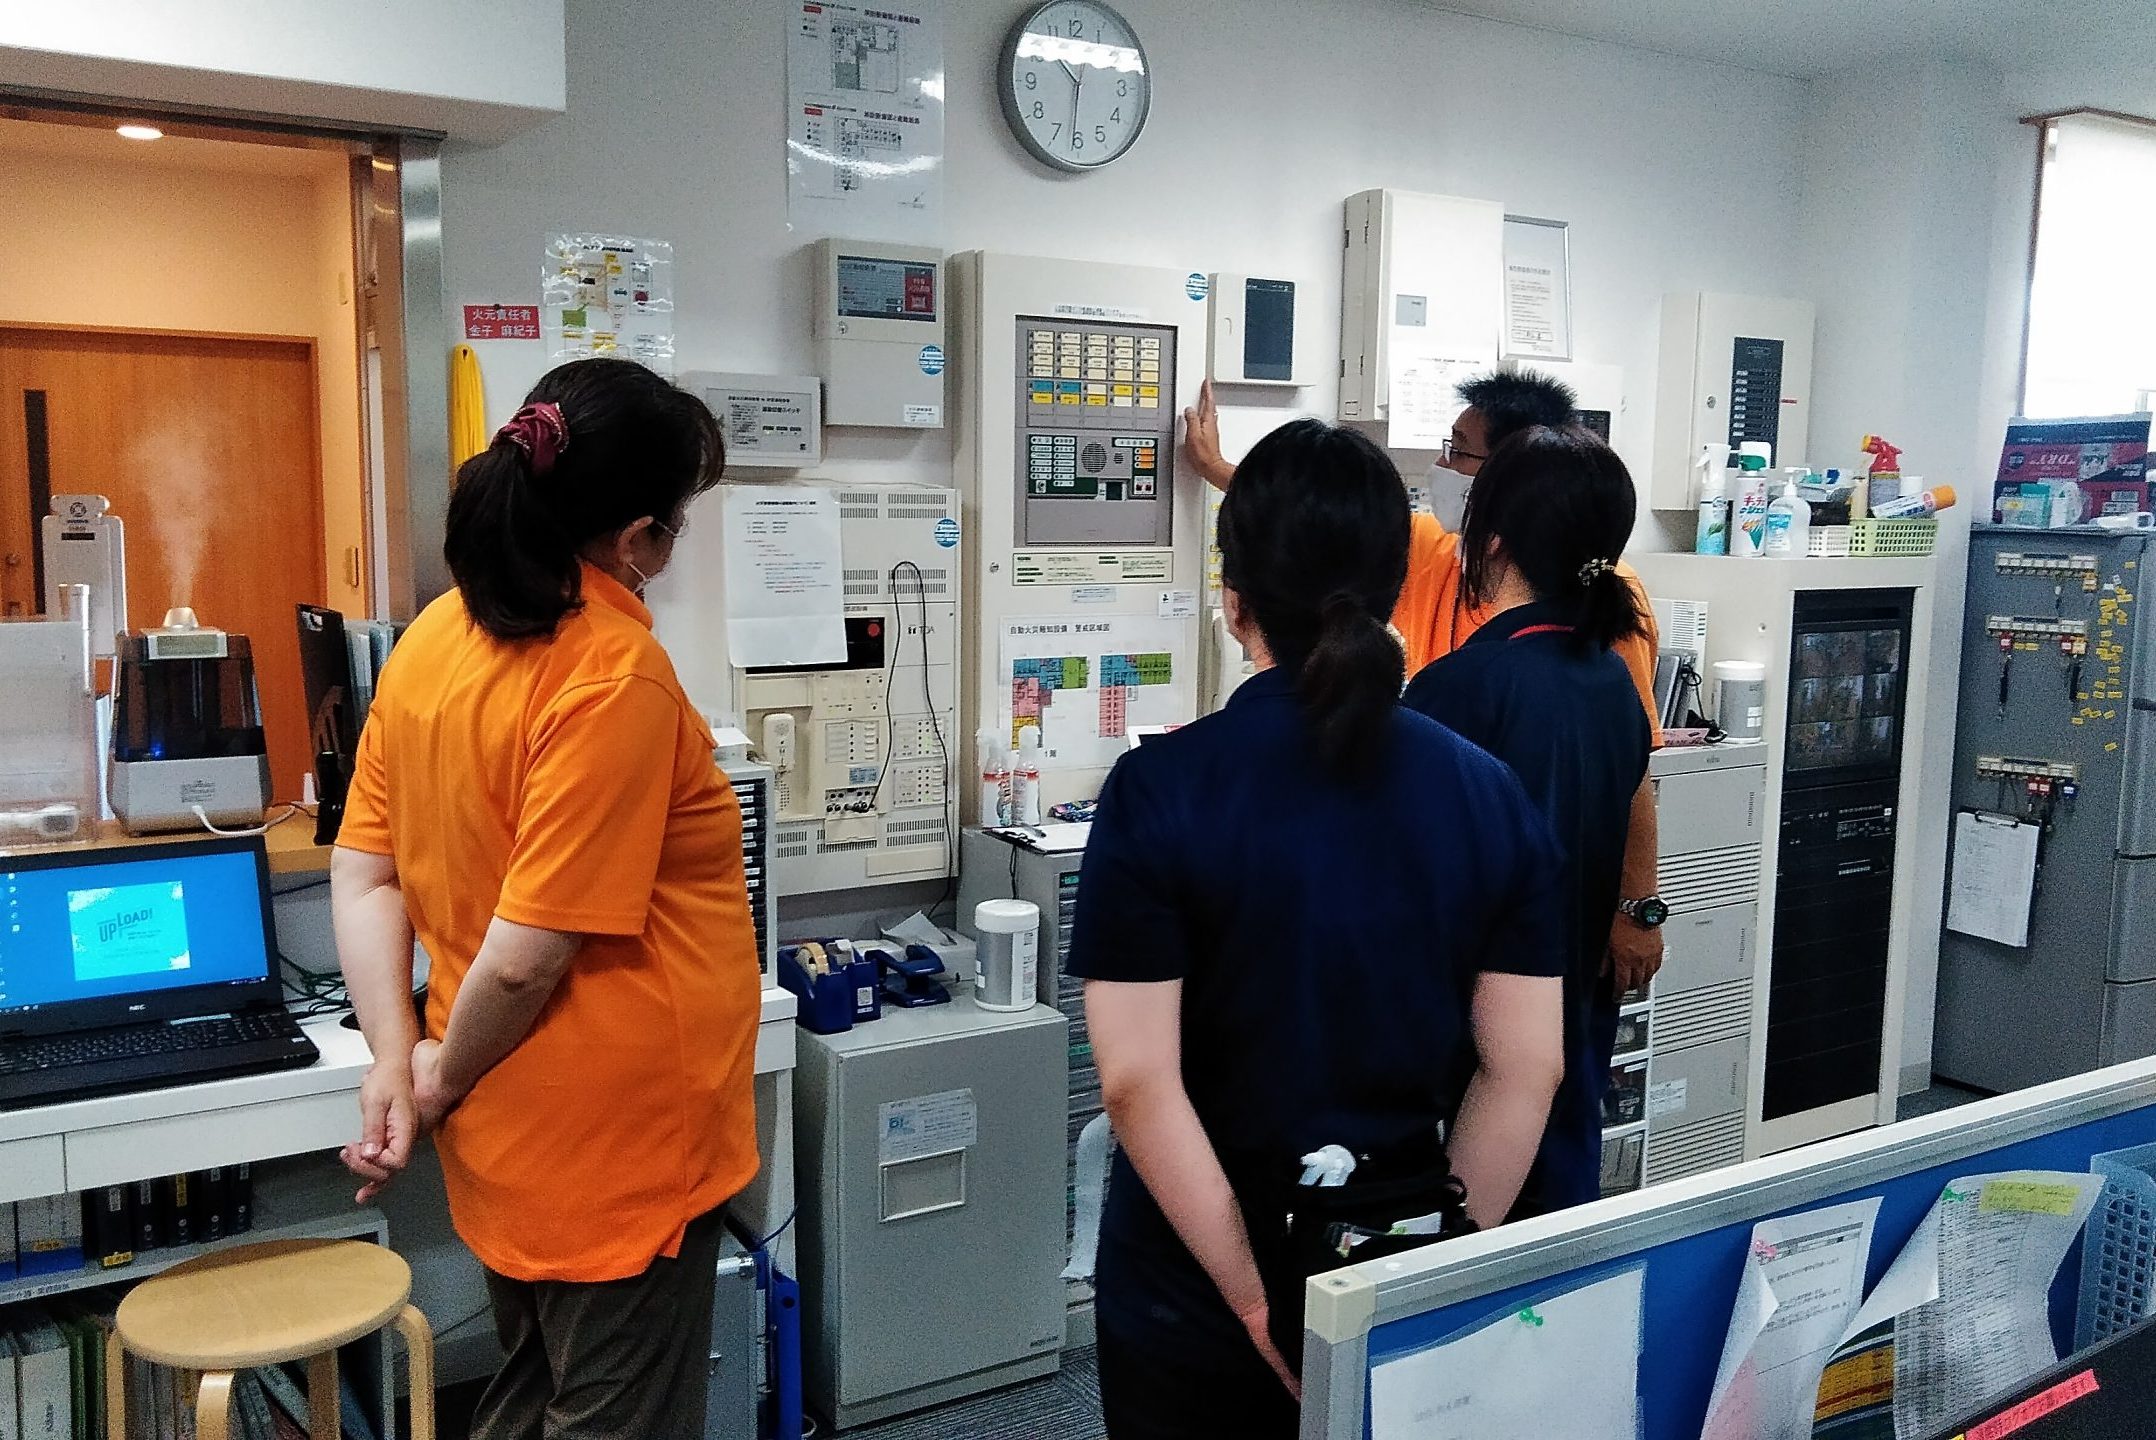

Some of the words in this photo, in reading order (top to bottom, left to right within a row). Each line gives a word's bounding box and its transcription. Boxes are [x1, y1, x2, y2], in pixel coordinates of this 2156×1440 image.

[1069, 19, 1083, 38] 12
[1025, 72, 1037, 90] 9
[1116, 79, 1127, 97] 3
[1033, 101, 1044, 119] 8
[1110, 107, 1121, 124] 4
[1051, 123, 1062, 141] 7
[1072, 131, 1084, 149] 6
[1095, 126, 1106, 143] 5
[472, 308, 531, 321] 火元責任者
[468, 324, 493, 337] 金子
[501, 324, 538, 337] 麻紀子
[128, 1003, 146, 1012] NEC
